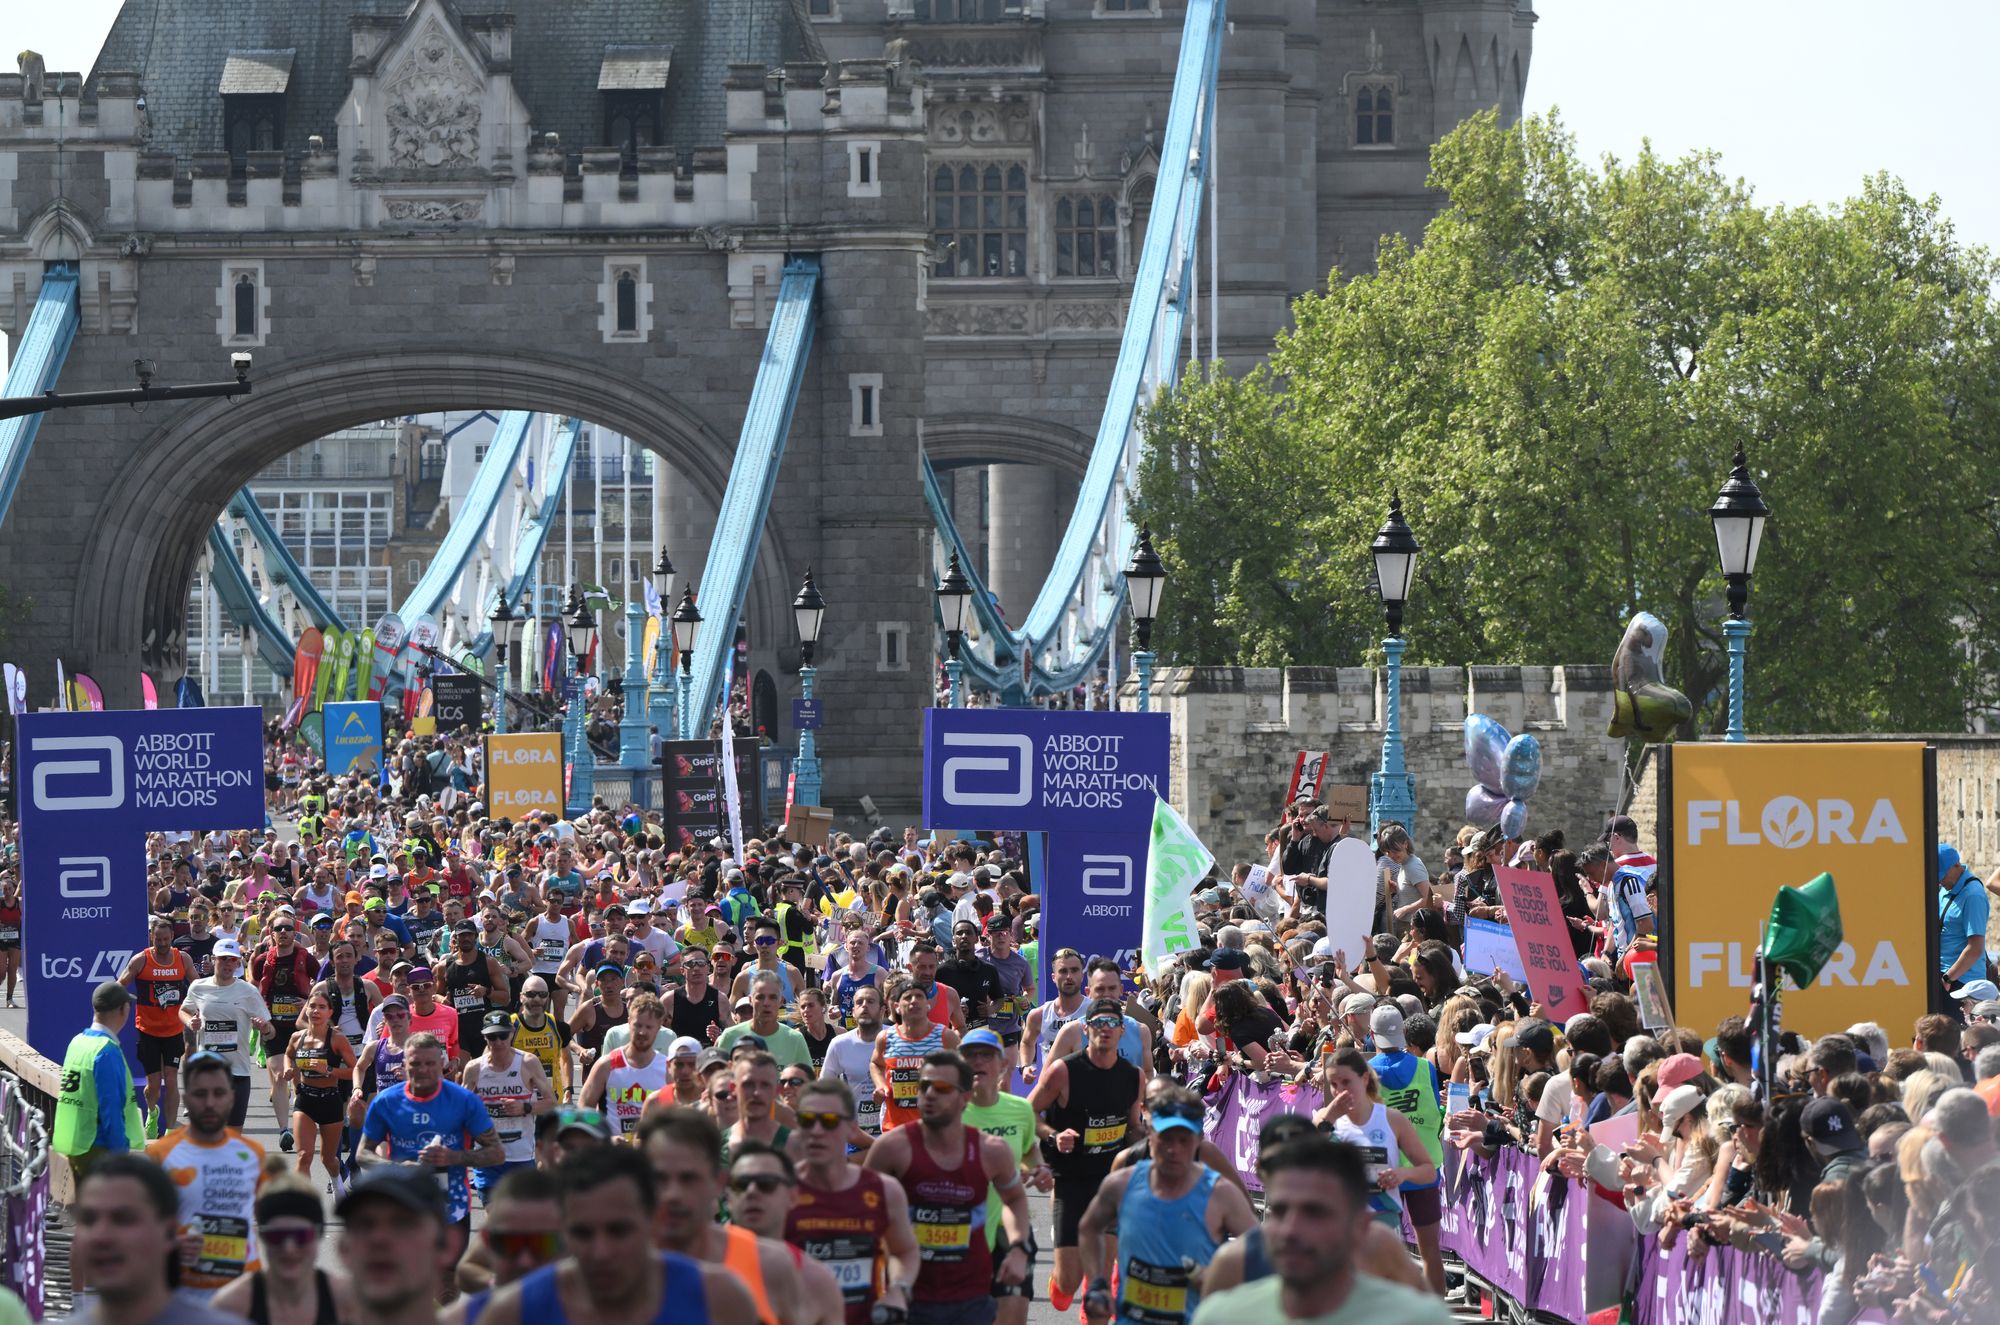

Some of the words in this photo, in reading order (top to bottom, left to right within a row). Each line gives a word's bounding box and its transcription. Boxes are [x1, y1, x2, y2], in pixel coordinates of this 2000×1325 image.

[437, 702, 464, 721] tcs
[135, 733, 215, 752] ABBOTT
[335, 734, 375, 746] Lucozade
[1044, 735, 1123, 752] ABBOTT
[134, 753, 211, 770] WORLD
[492, 748, 557, 765] FLORA
[1043, 754, 1118, 771] WORLD
[135, 769, 252, 789] MARATHON
[1043, 772, 1157, 790] MARATHON
[136, 789, 217, 808] MAJORS
[493, 788, 558, 806] FLORA
[1043, 791, 1123, 808] MAJORS
[1687, 795, 1909, 849] FLORA
[1511, 883, 1532, 898] THIS
[1533, 886, 1543, 899] IS
[1082, 905, 1133, 917] ABBOTT
[1513, 896, 1549, 912] BLOODY
[62, 906, 112, 919] ABBOTT
[1517, 910, 1552, 926] TOUGH.
[1528, 942, 1545, 956] BUT
[1546, 945, 1561, 958] SO
[41, 953, 83, 978] tcs
[1530, 956, 1546, 969] ARE
[1548, 959, 1569, 972] YOU.
[1689, 941, 1910, 991] FLRA
[152, 968, 178, 977] STOCKY
[273, 995, 285, 1004] tcs
[454, 988, 465, 996] tcs
[206, 1022, 219, 1031] tcs
[524, 1037, 548, 1048] ANGELO
[896, 1057, 925, 1069] DAVID
[893, 1070, 909, 1081] tcs
[479, 1085, 523, 1096] ENGLAND
[860, 1104, 874, 1112] tcs
[412, 1112, 431, 1125] ED
[1089, 1116, 1105, 1128] tcs
[1096, 1129, 1119, 1142] 3035
[916, 1208, 939, 1223] tcs
[926, 1228, 958, 1244] 3594
[806, 1240, 832, 1258] tcs
